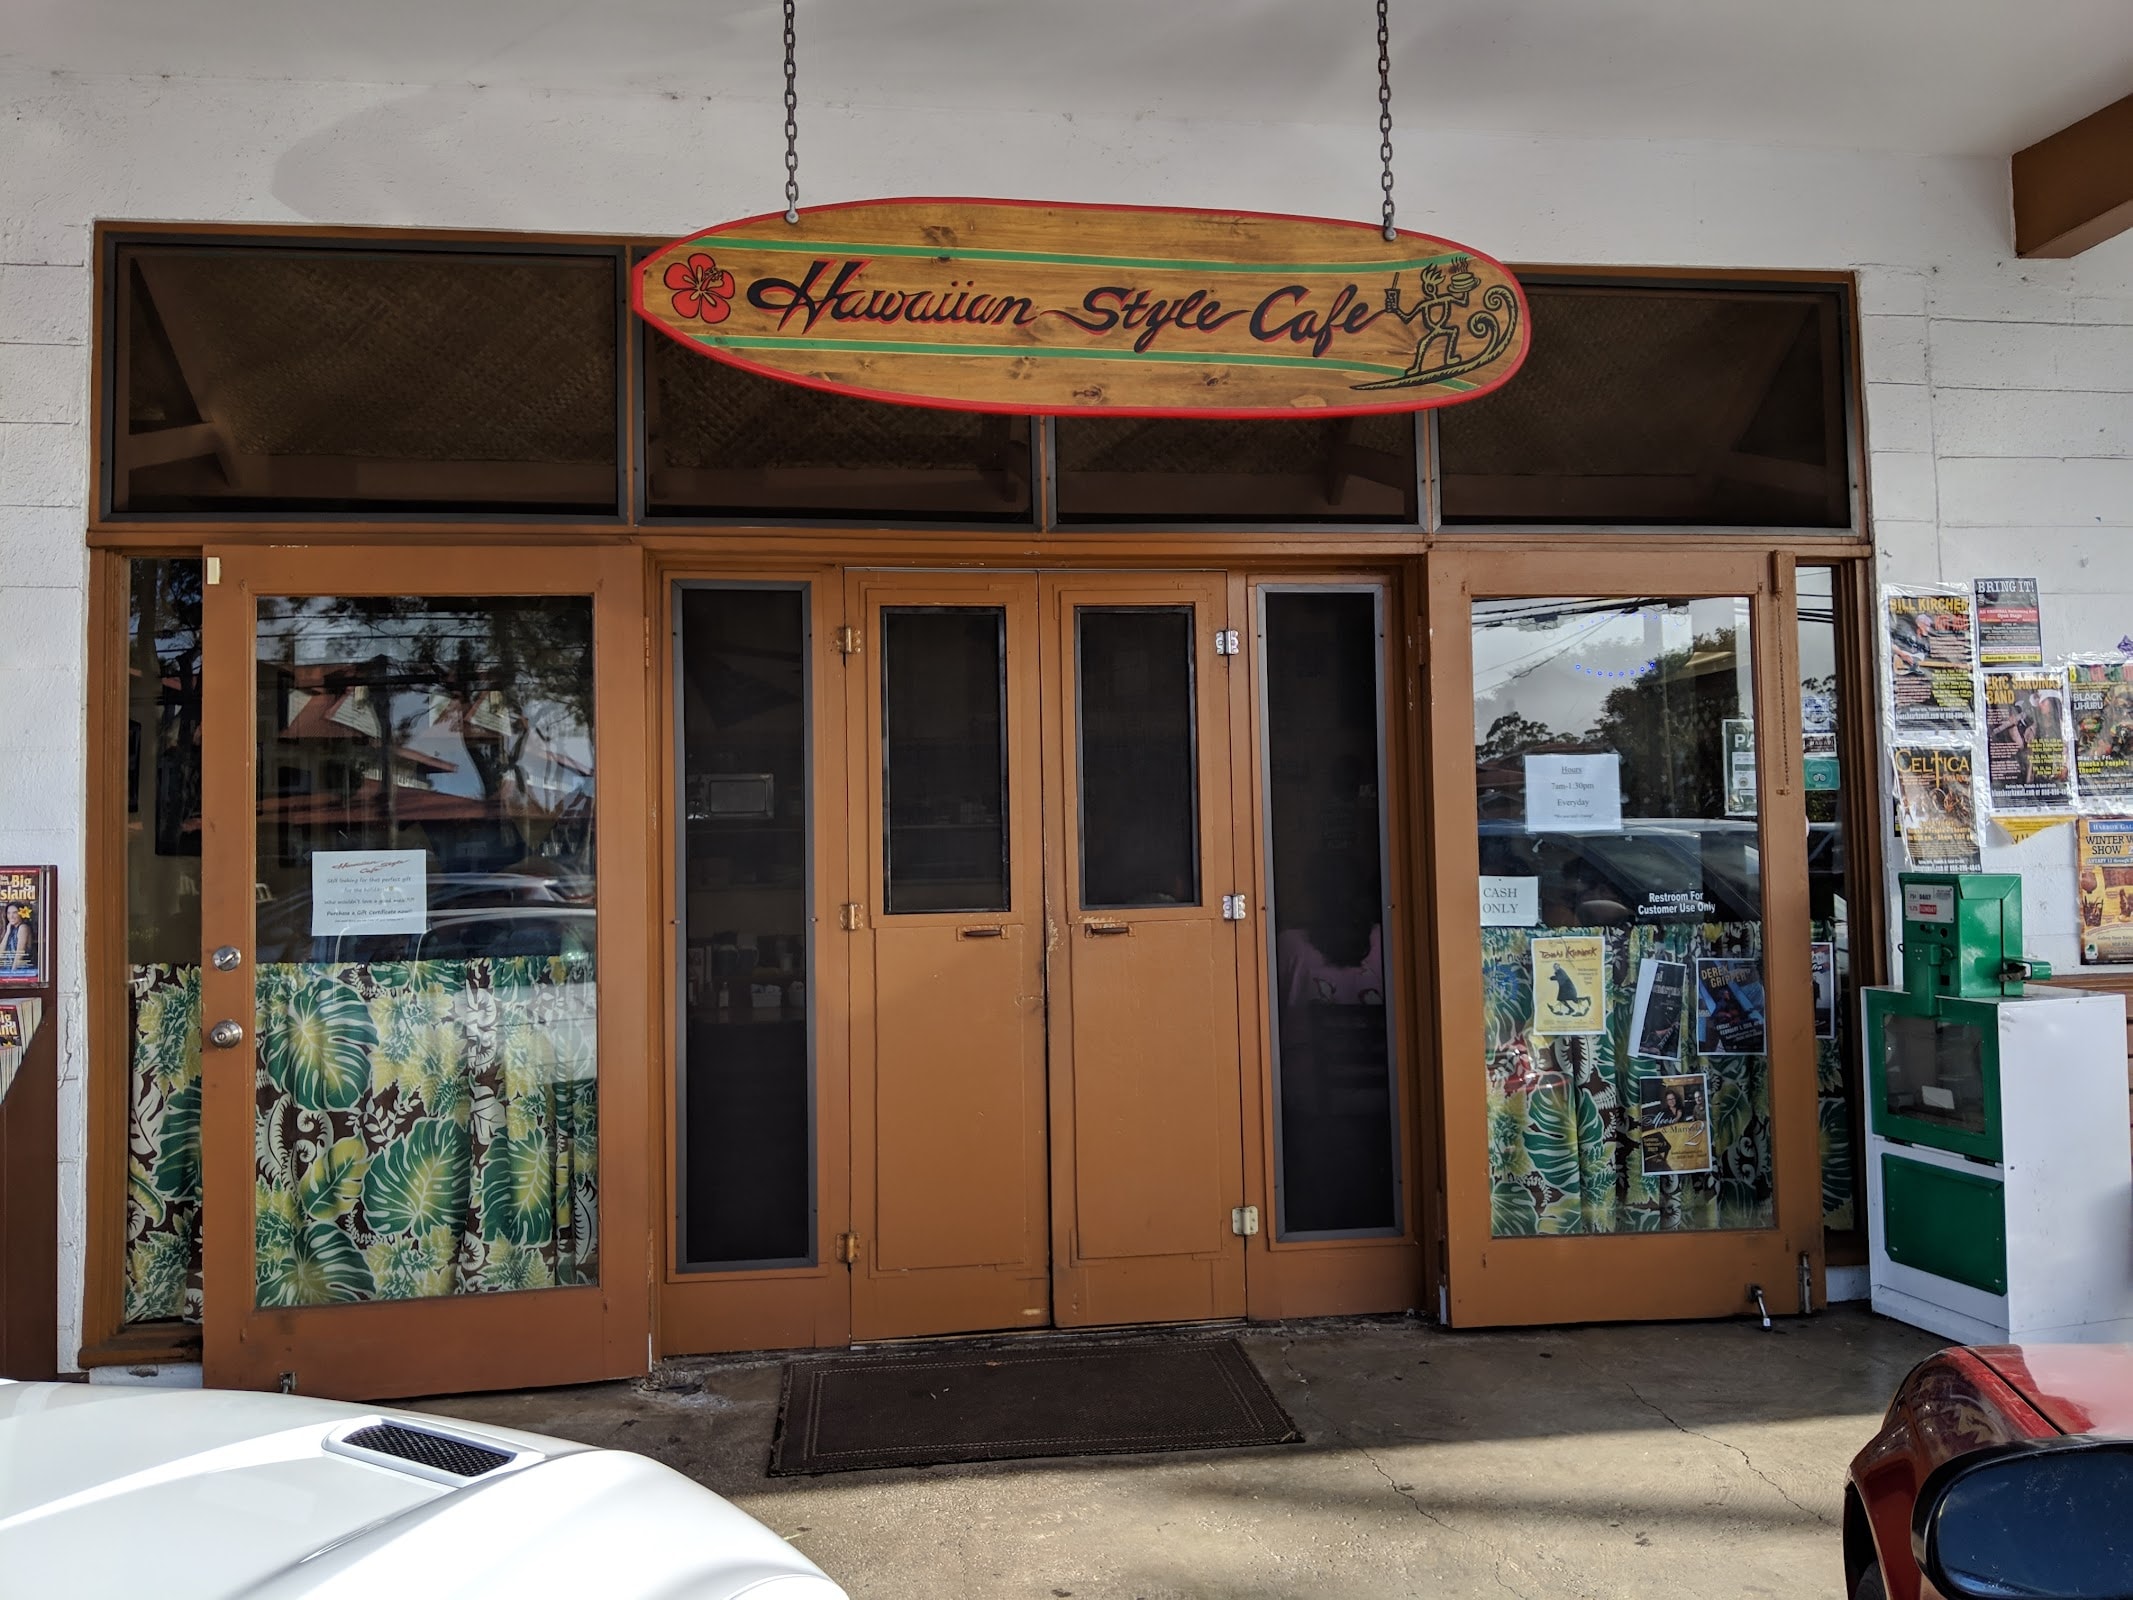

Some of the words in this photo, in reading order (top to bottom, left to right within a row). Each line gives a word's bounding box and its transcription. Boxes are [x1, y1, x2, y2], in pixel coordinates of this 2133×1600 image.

[747, 258, 1037, 335] Hawaiian
[1041, 286, 1252, 354] Style
[1249, 284, 1384, 357] Cafe
[1977, 580, 2016, 593] BRING
[2018, 580, 2035, 593] IT!
[1889, 597, 1916, 611] BILL
[1985, 675, 2009, 690] ERIC
[1986, 690, 2015, 704] BAND
[2073, 693, 2103, 701] BLACK
[2074, 702, 2104, 710] UHURU
[1895, 750, 1970, 786] CELTICA
[1557, 798, 1589, 807] Everyday
[2085, 835, 2124, 845] WINTER
[2092, 845, 2122, 855] SHOW
[12, 875, 32, 891] Big
[0, 886, 35, 900] sland
[1483, 888, 1517, 898] CASH
[1648, 892, 1688, 902] Restroom
[1690, 891, 1704, 900] For
[1482, 903, 1519, 914] ONLY
[1637, 904, 1678, 915] Customer
[1679, 902, 1695, 913] Use
[1697, 901, 1716, 914] Only
[1701, 965, 1729, 980] DEREK
[1710, 970, 1748, 988] GRIPPER
